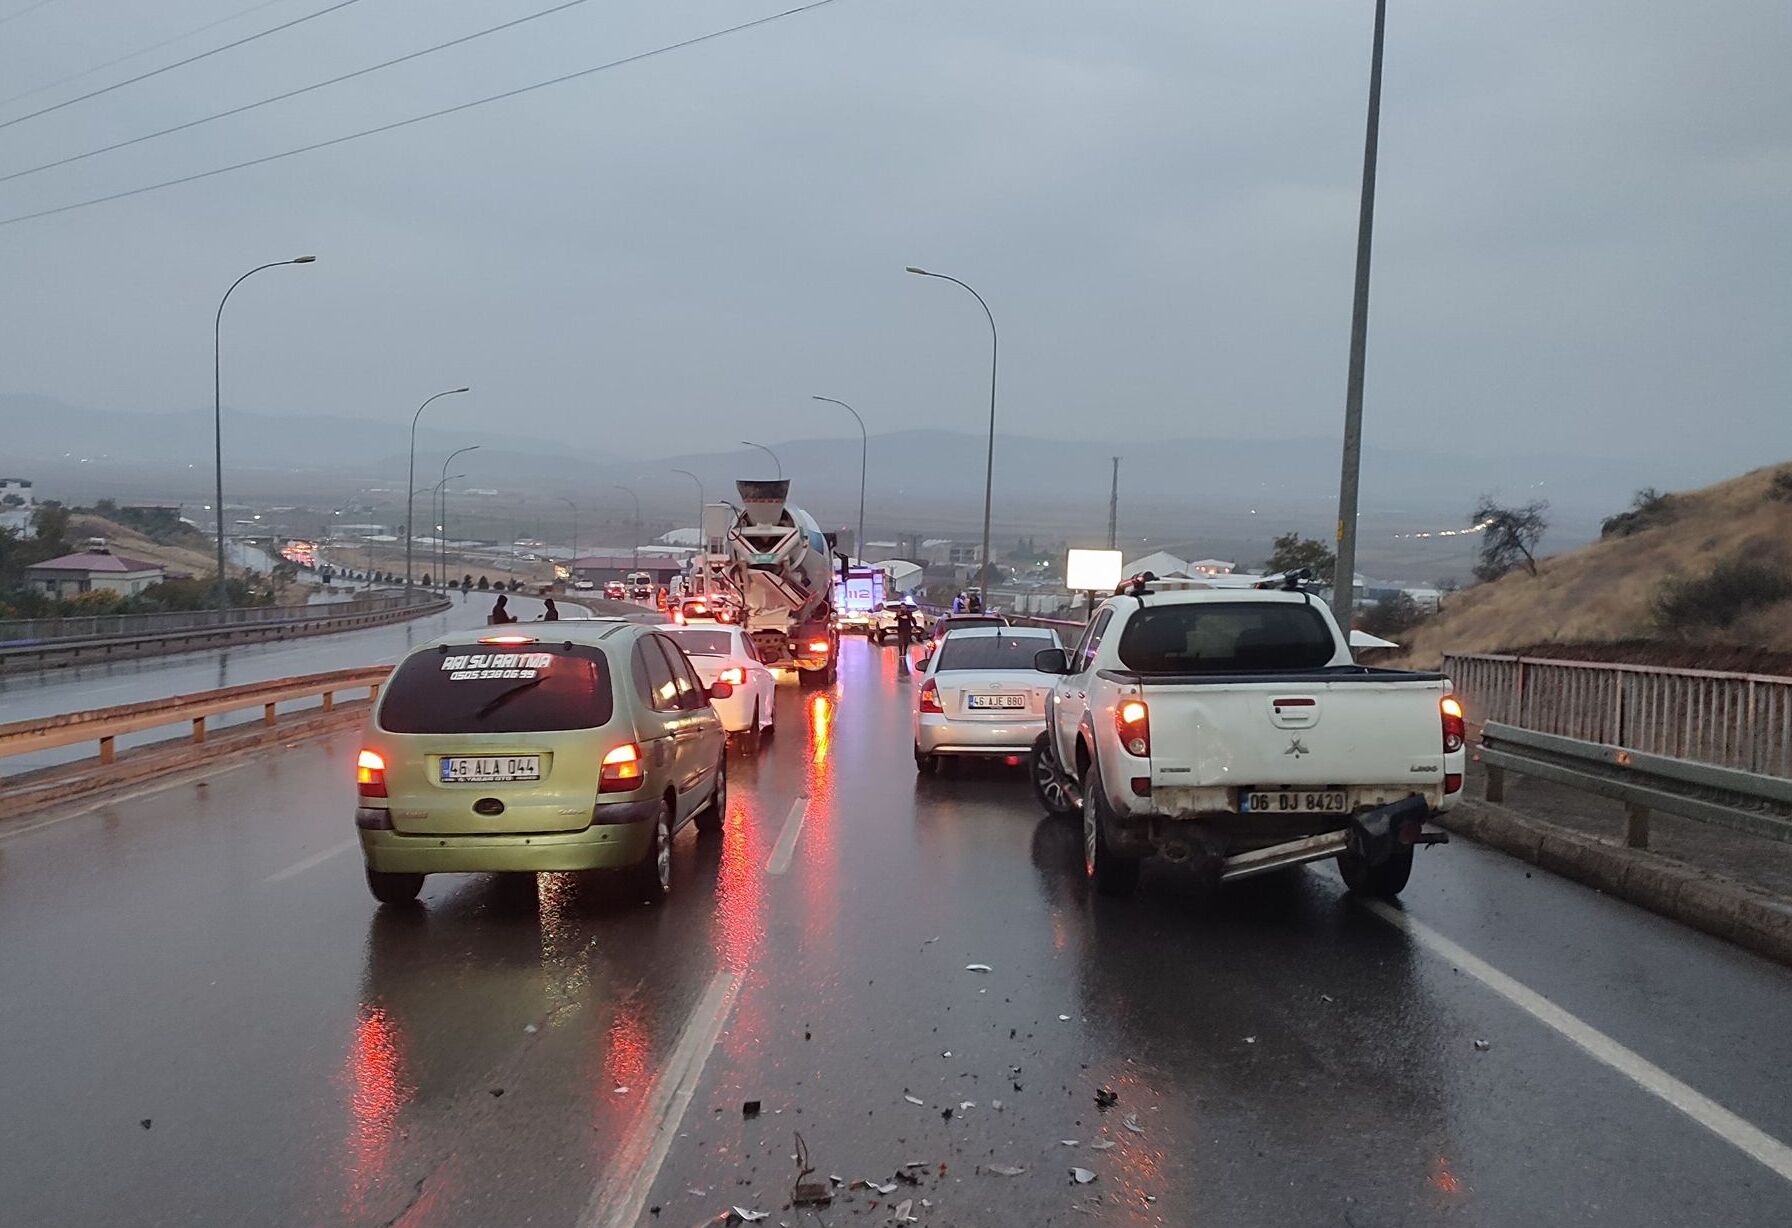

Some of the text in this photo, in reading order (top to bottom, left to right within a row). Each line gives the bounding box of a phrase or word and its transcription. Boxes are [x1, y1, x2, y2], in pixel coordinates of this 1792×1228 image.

[849, 590, 870, 598] 112
[467, 654, 493, 669] SU
[491, 653, 552, 668] ARITMA
[450, 671, 479, 680] 0505
[974, 696, 985, 706] 46
[989, 696, 1003, 706] AJE
[450, 759, 534, 775] 46 ALA 044
[1250, 794, 1343, 810] 06 DJ 8429
